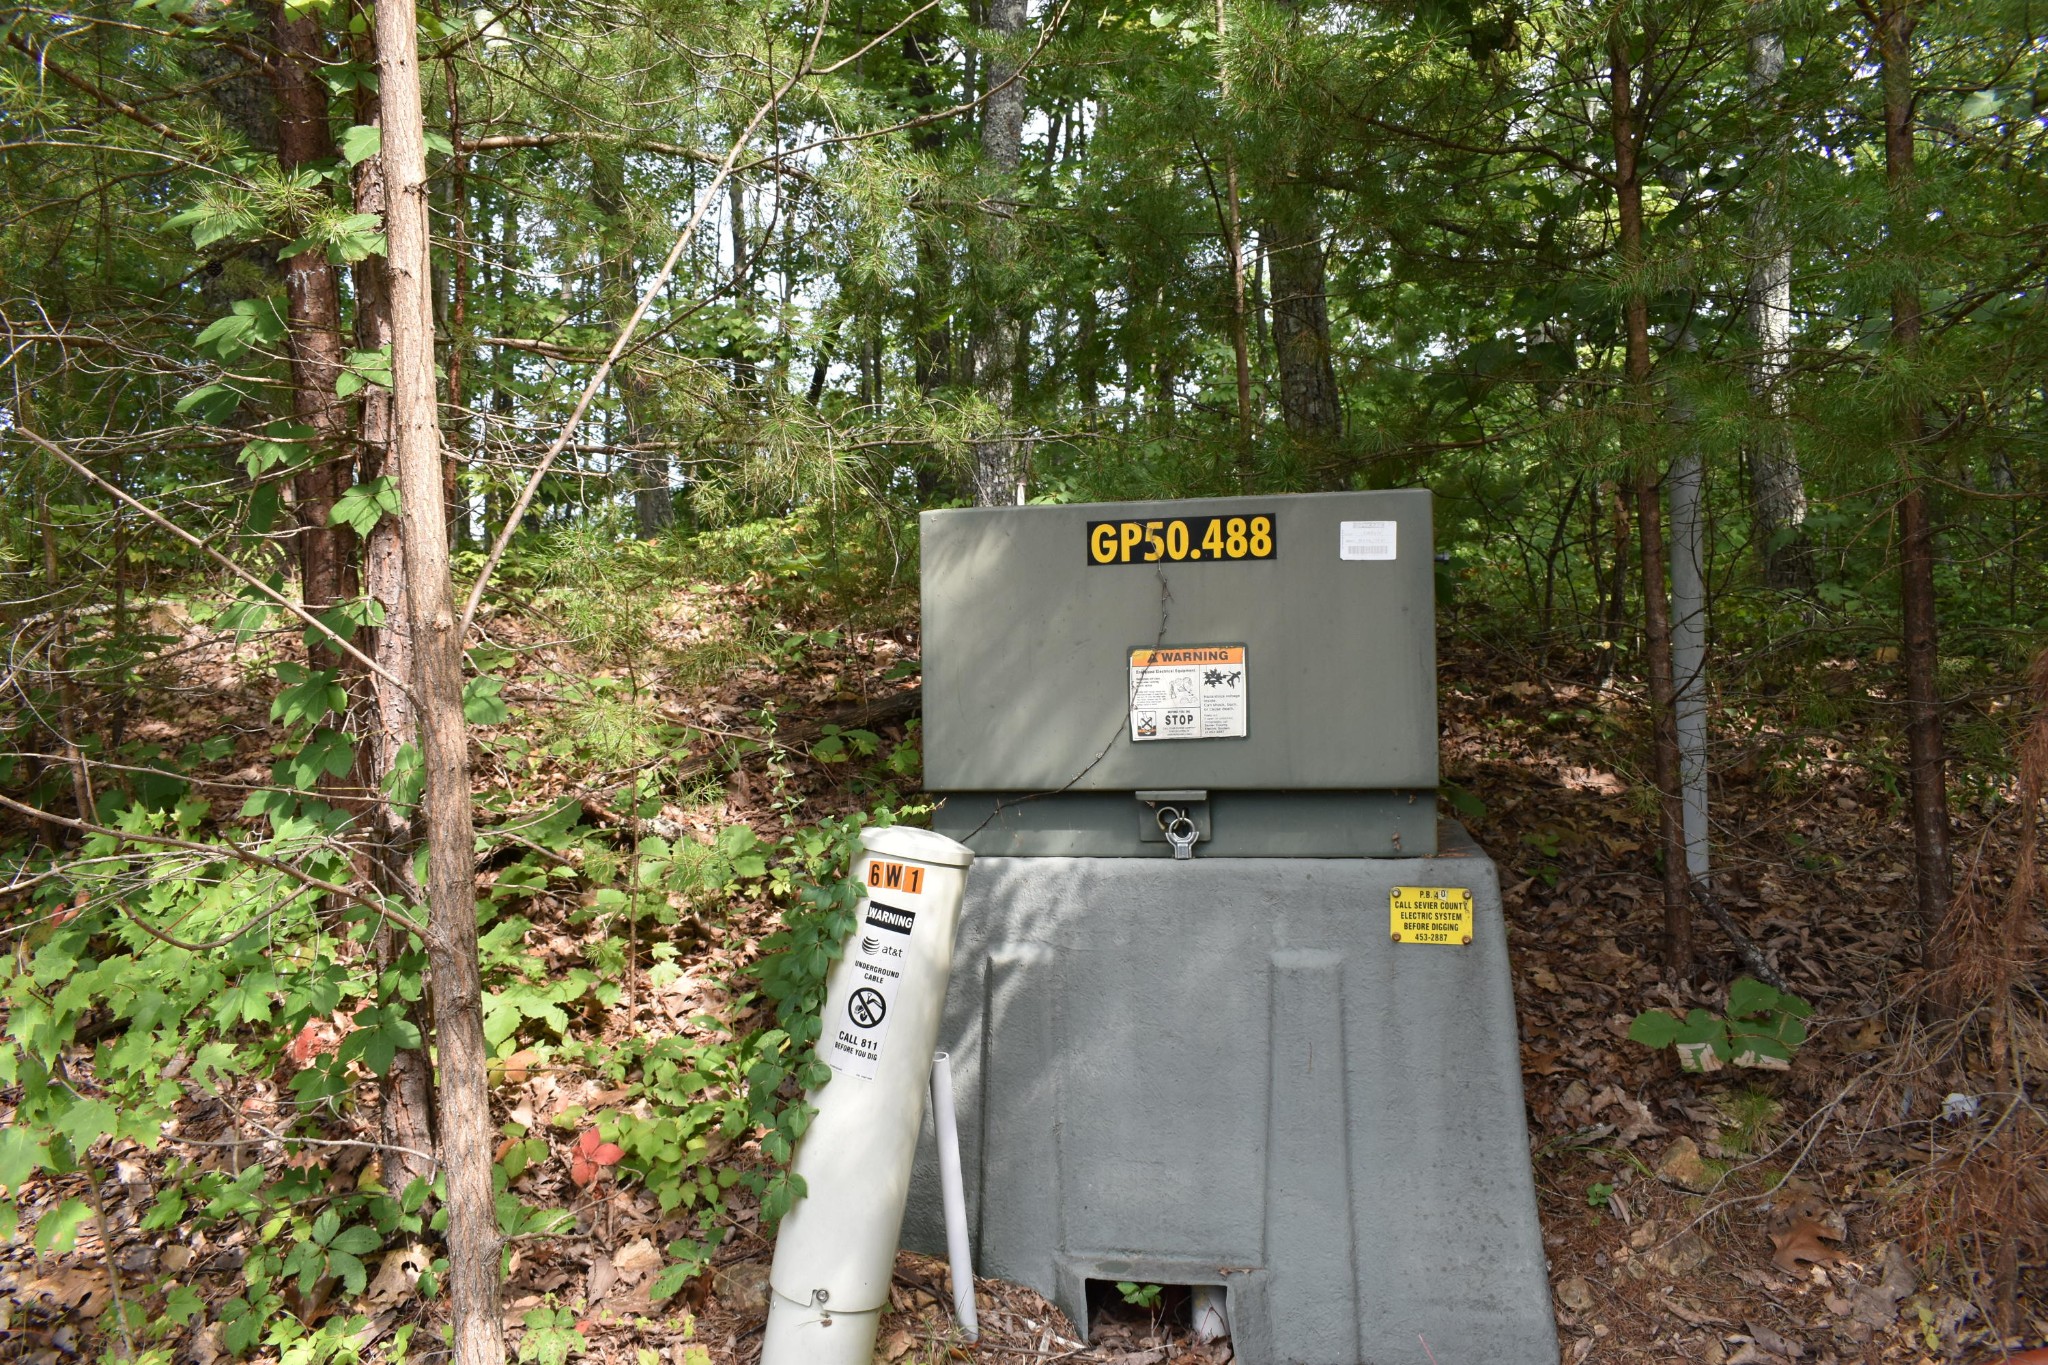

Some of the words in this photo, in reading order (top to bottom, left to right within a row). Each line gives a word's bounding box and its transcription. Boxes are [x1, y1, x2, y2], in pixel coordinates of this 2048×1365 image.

[1091, 516, 1272, 564] GP50.488
[1161, 651, 1229, 662] WARNING
[1165, 714, 1194, 725] STOP
[1395, 901, 1412, 909] CALL
[1414, 901, 1438, 910] SEVIER
[1440, 902, 1468, 910] COUNTY
[868, 906, 913, 929] WARNING
[1401, 912, 1433, 920] ELECTRIC
[1434, 912, 1462, 921] SYSTEM
[1404, 922, 1430, 930] BEFORE
[1432, 923, 1459, 931] DIGGING
[1415, 933, 1448, 942] 453-2887
[882, 946, 903, 958] at&t
[855, 960, 900, 979] UNDERGROUND
[864, 972, 884, 984] CABLE
[839, 1030, 858, 1046] CALL
[861, 1038, 878, 1051] 811
[835, 1041, 853, 1054] BEFORE
[855, 1048, 867, 1058] YOU
[867, 1052, 878, 1061] DIG
